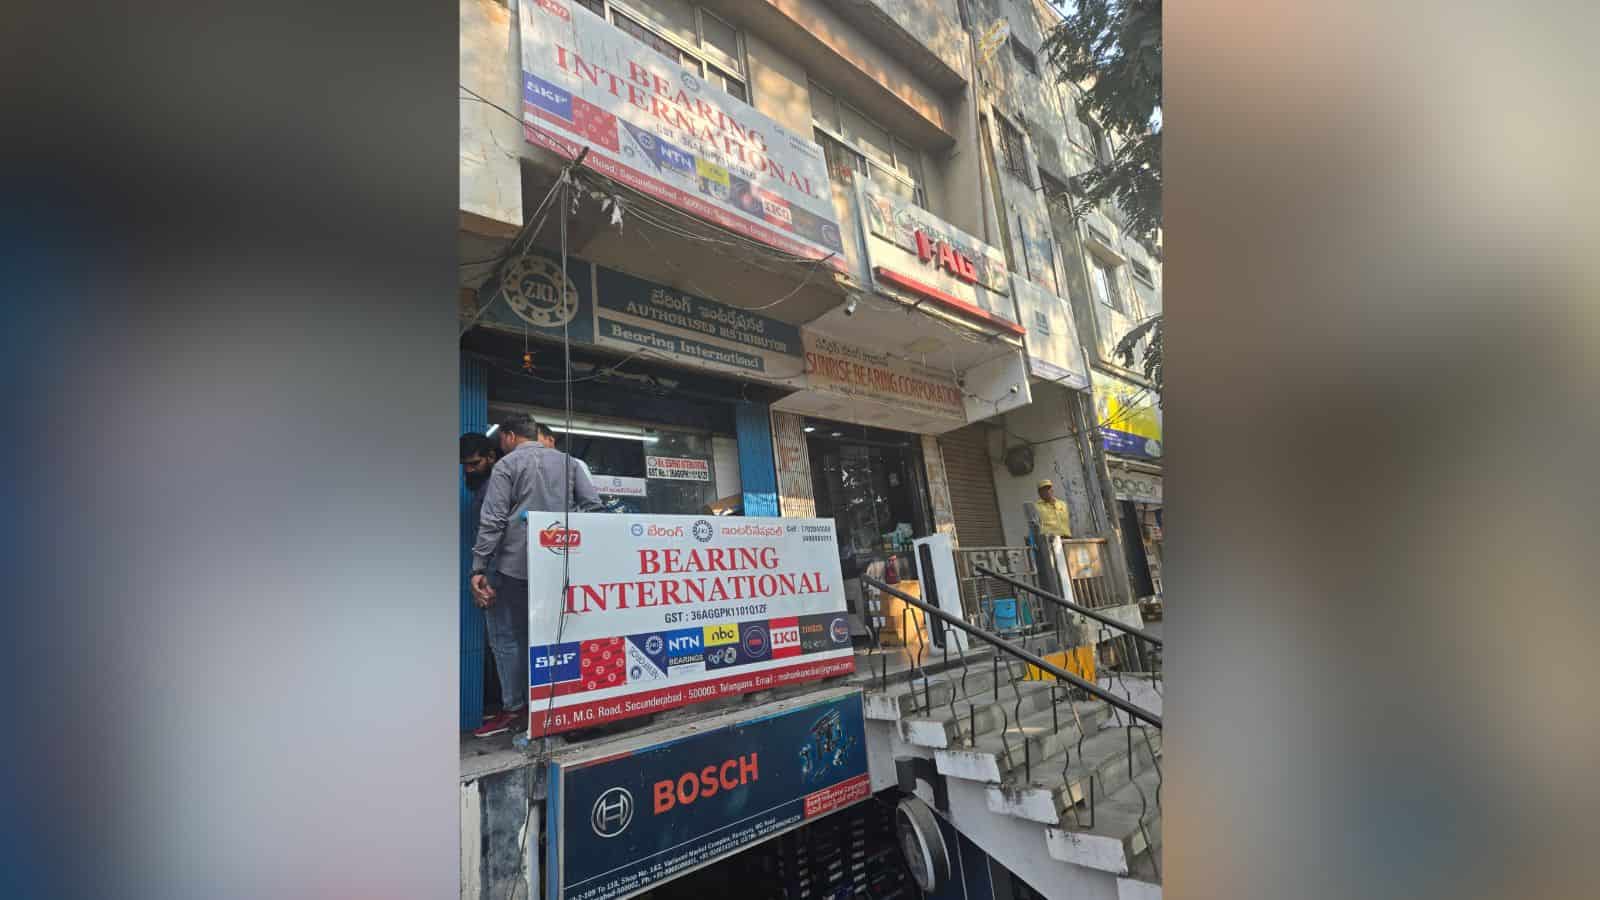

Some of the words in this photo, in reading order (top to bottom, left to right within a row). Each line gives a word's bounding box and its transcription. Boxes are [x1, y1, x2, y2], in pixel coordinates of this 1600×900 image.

[554, 42, 819, 199] INTERNATIONAL
[627, 60, 769, 153] BEARING
[915, 229, 978, 284] FAG
[626, 300, 717, 335] AUTHORISED
[611, 323, 675, 350] Bearing
[806, 352, 850, 382] SUNRISE
[637, 546, 780, 576] BEARING
[564, 571, 830, 615] INTERNATIONAL
[665, 611, 683, 624] GST
[669, 635, 700, 652] NTN
[773, 631, 798, 645] IKO
[625, 692, 682, 713] Secunderabad
[653, 752, 759, 815] BOSCH
